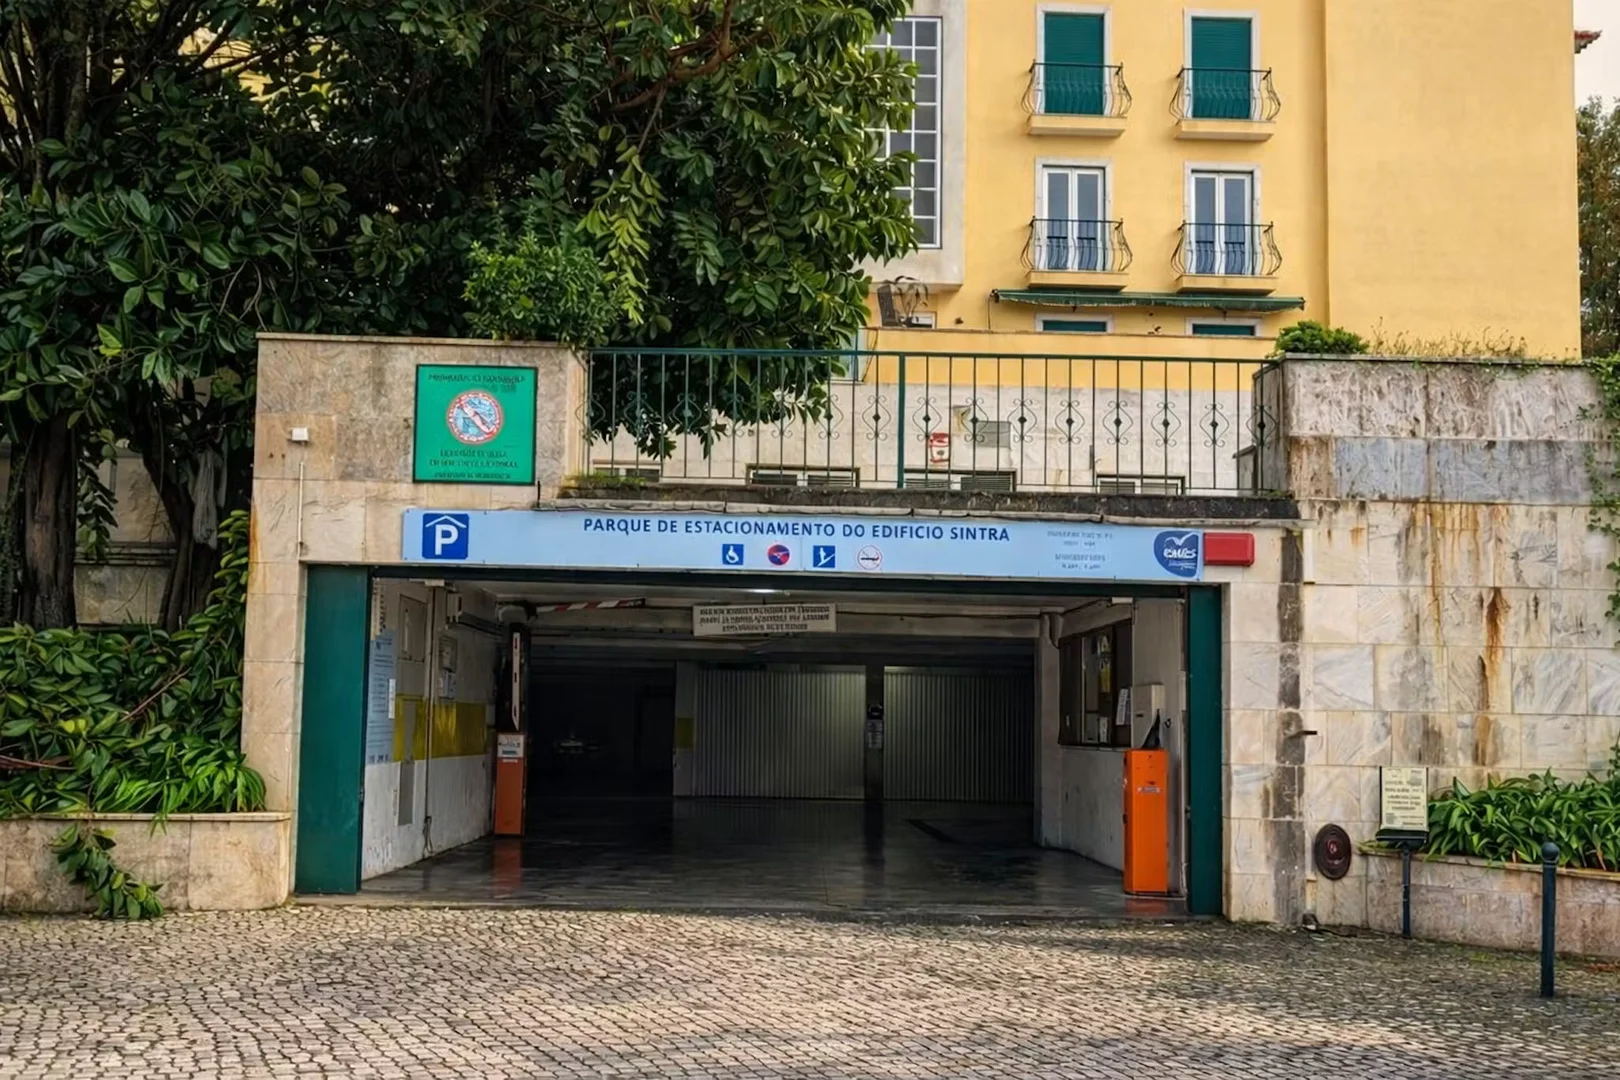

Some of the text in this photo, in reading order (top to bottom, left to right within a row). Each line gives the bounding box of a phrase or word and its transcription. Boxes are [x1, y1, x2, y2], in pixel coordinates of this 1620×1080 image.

[435, 523, 459, 556] P
[583, 518, 1010, 542] PARQUE DE ESTACIONAMENTO DO EDIFICIO SINTRA
